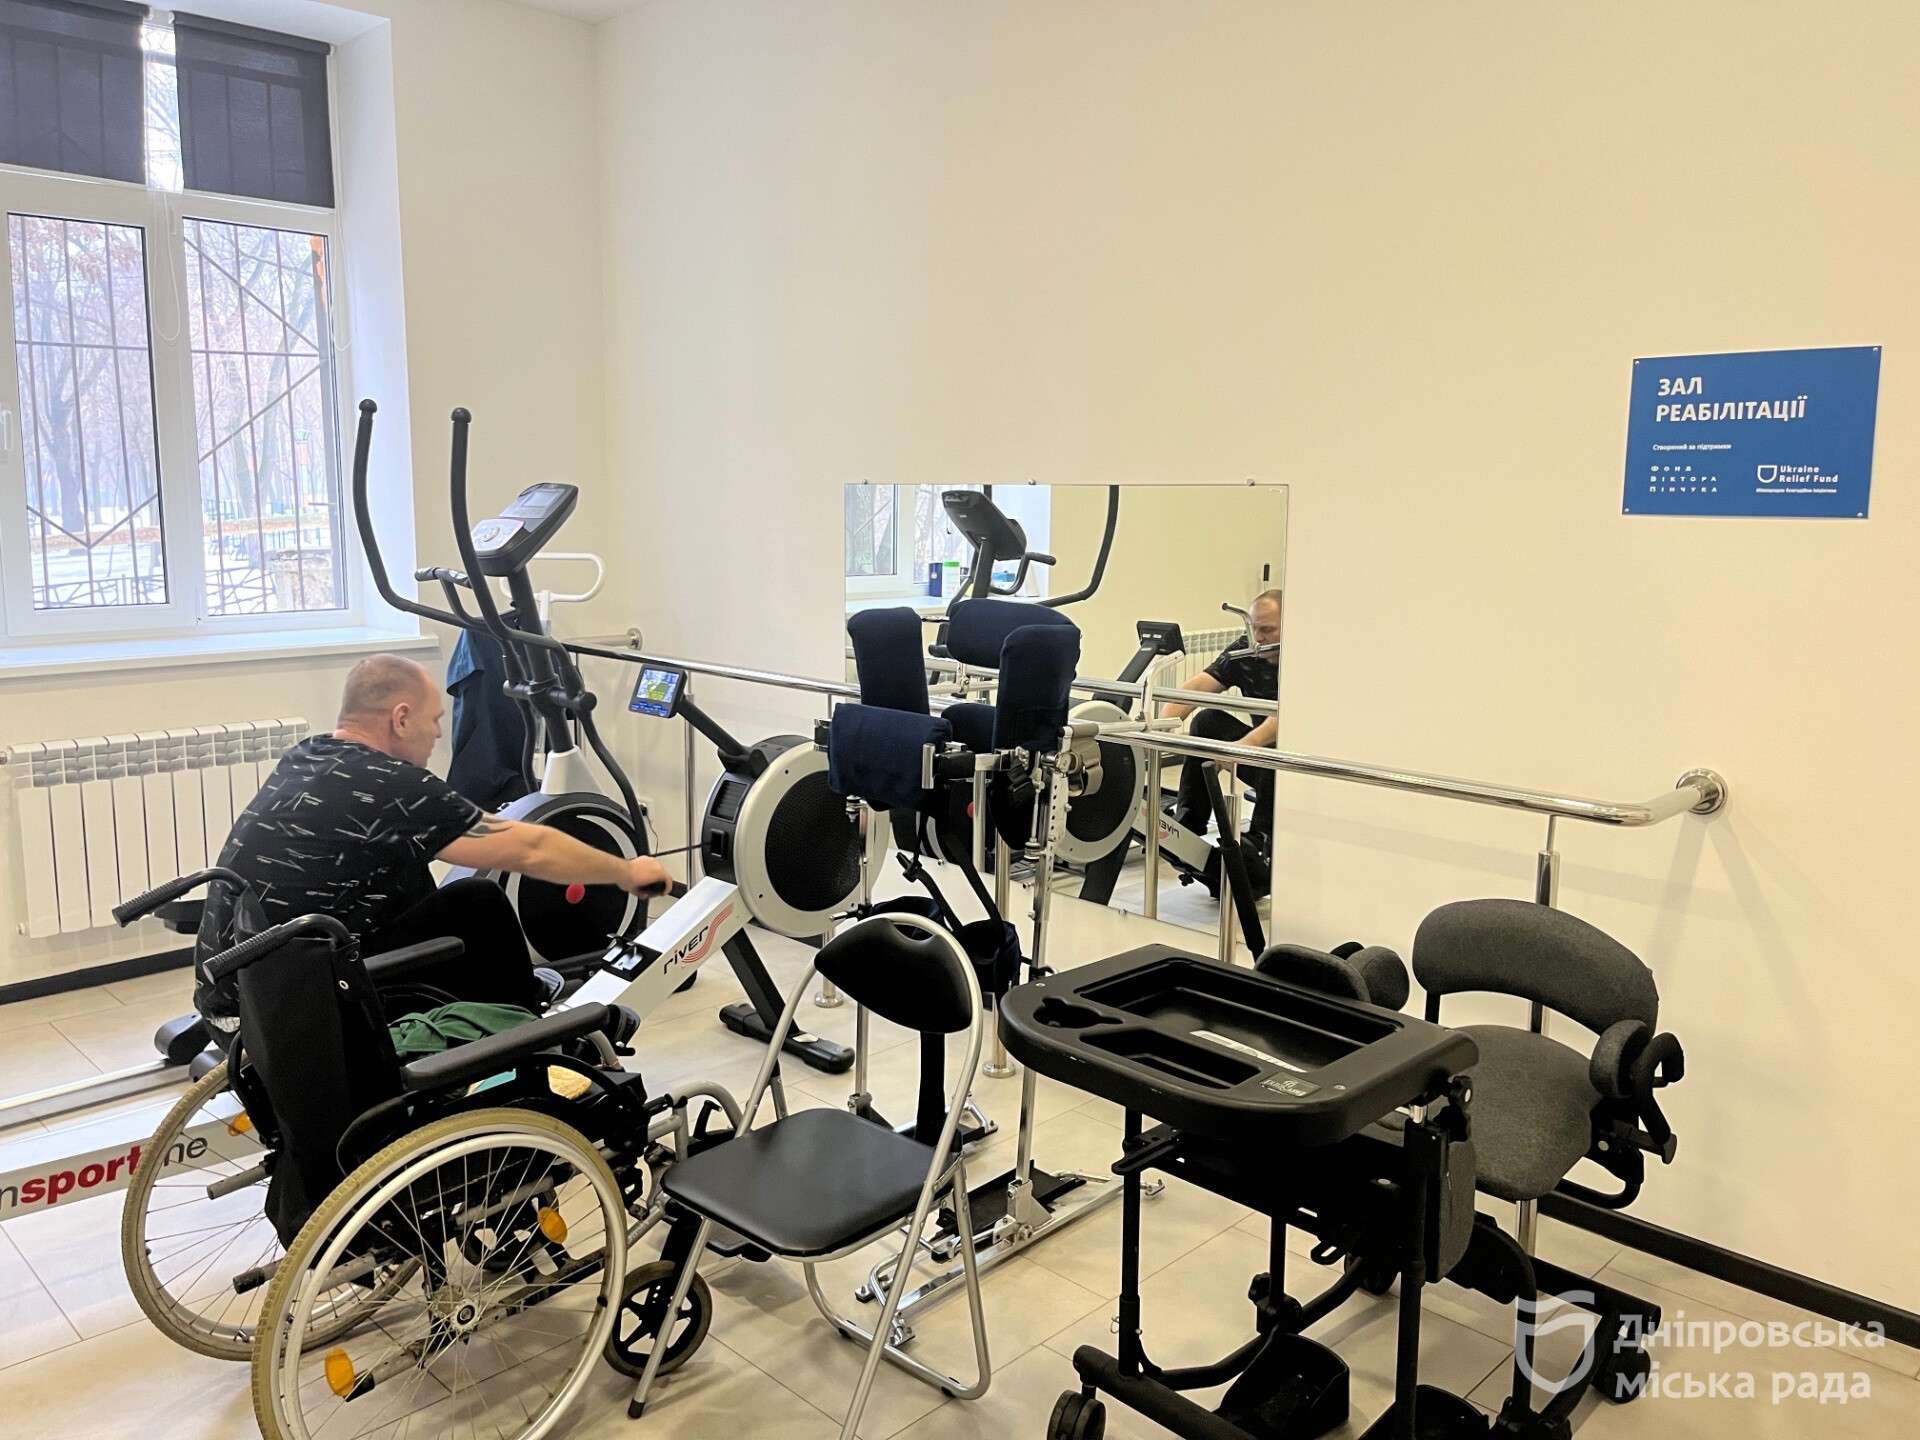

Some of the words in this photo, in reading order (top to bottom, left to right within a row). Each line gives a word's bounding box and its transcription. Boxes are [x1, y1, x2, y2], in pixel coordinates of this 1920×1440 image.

[1658, 376, 1702, 396] ЗАЛ
[1656, 396, 1808, 422] РЕАБІЛІТАЦІЇ
[1780, 474, 1810, 482] Relief
[1814, 474, 1838, 482] Fund
